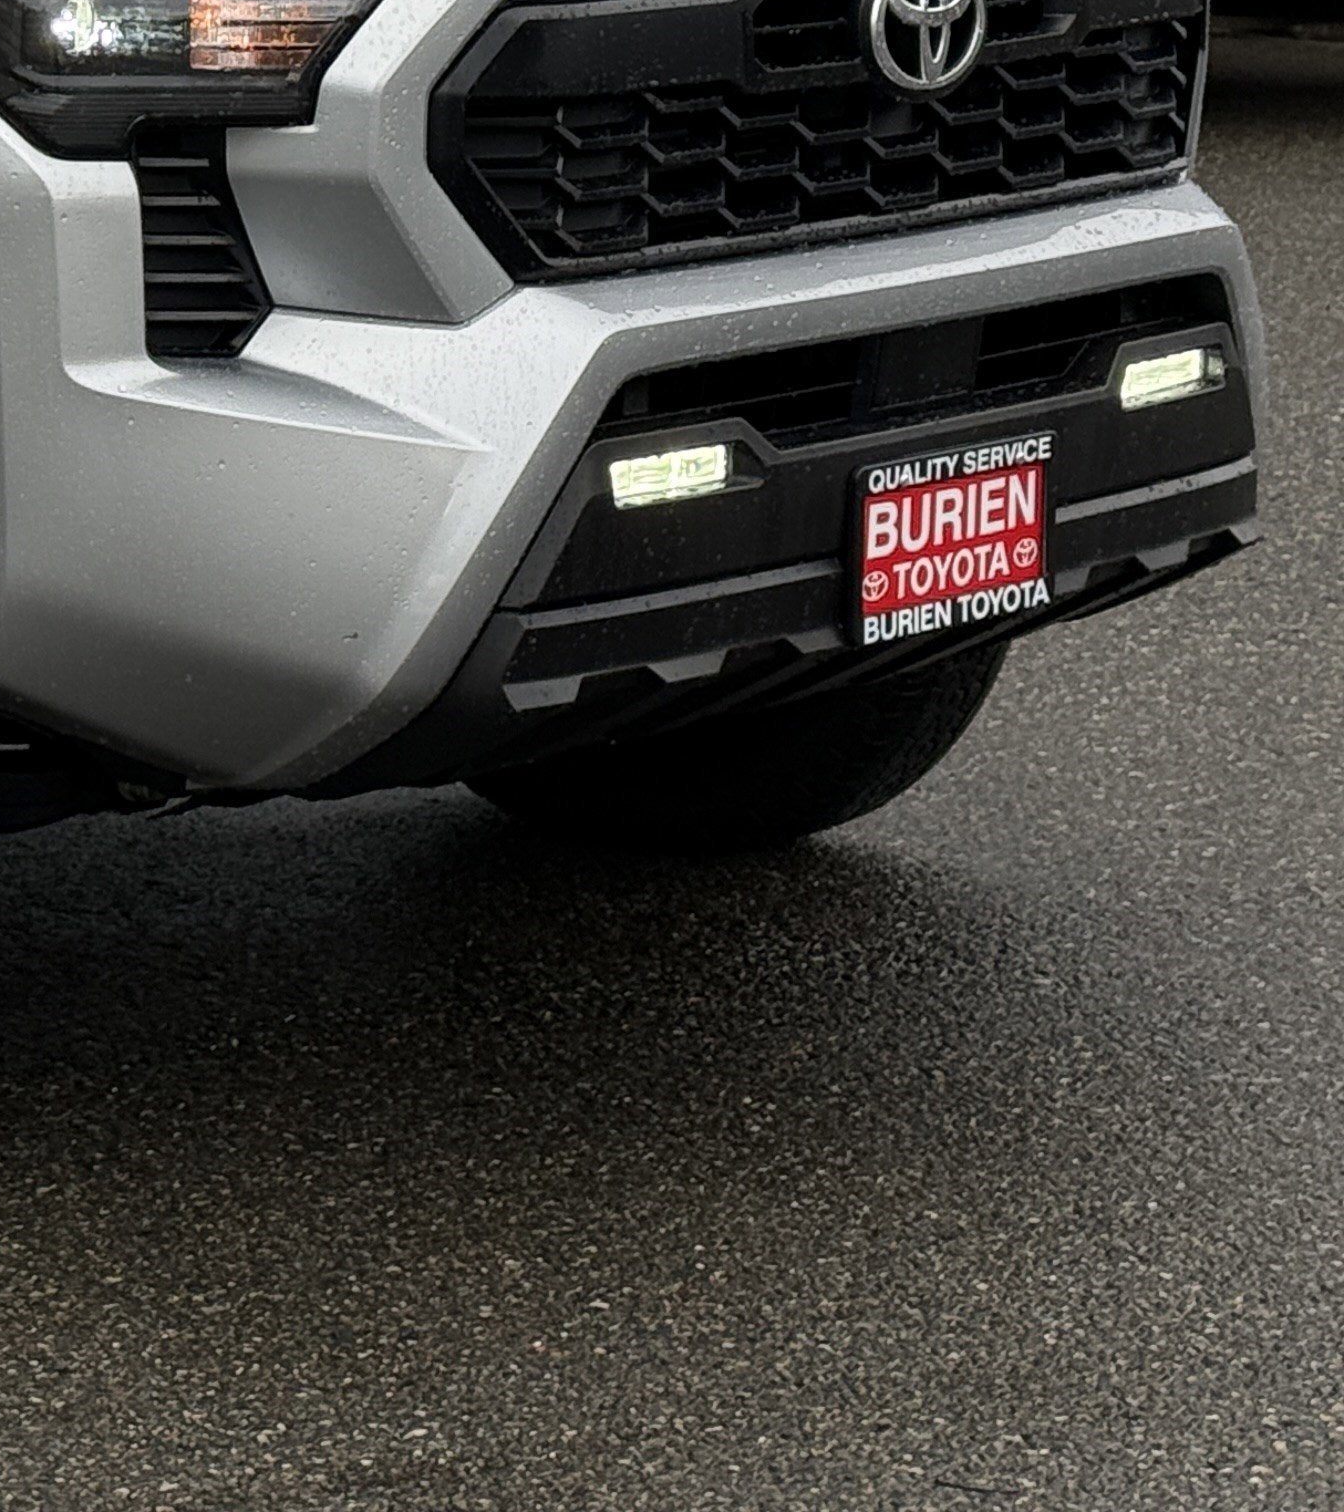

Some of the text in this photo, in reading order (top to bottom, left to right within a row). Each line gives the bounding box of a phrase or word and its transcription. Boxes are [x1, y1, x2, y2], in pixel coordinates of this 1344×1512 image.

[868, 435, 1053, 494] QUALITY SERVICE
[866, 469, 1037, 560] BURIEN
[892, 541, 1012, 600] TOYOTA
[863, 577, 1052, 646] BURIEN TOYOTA
